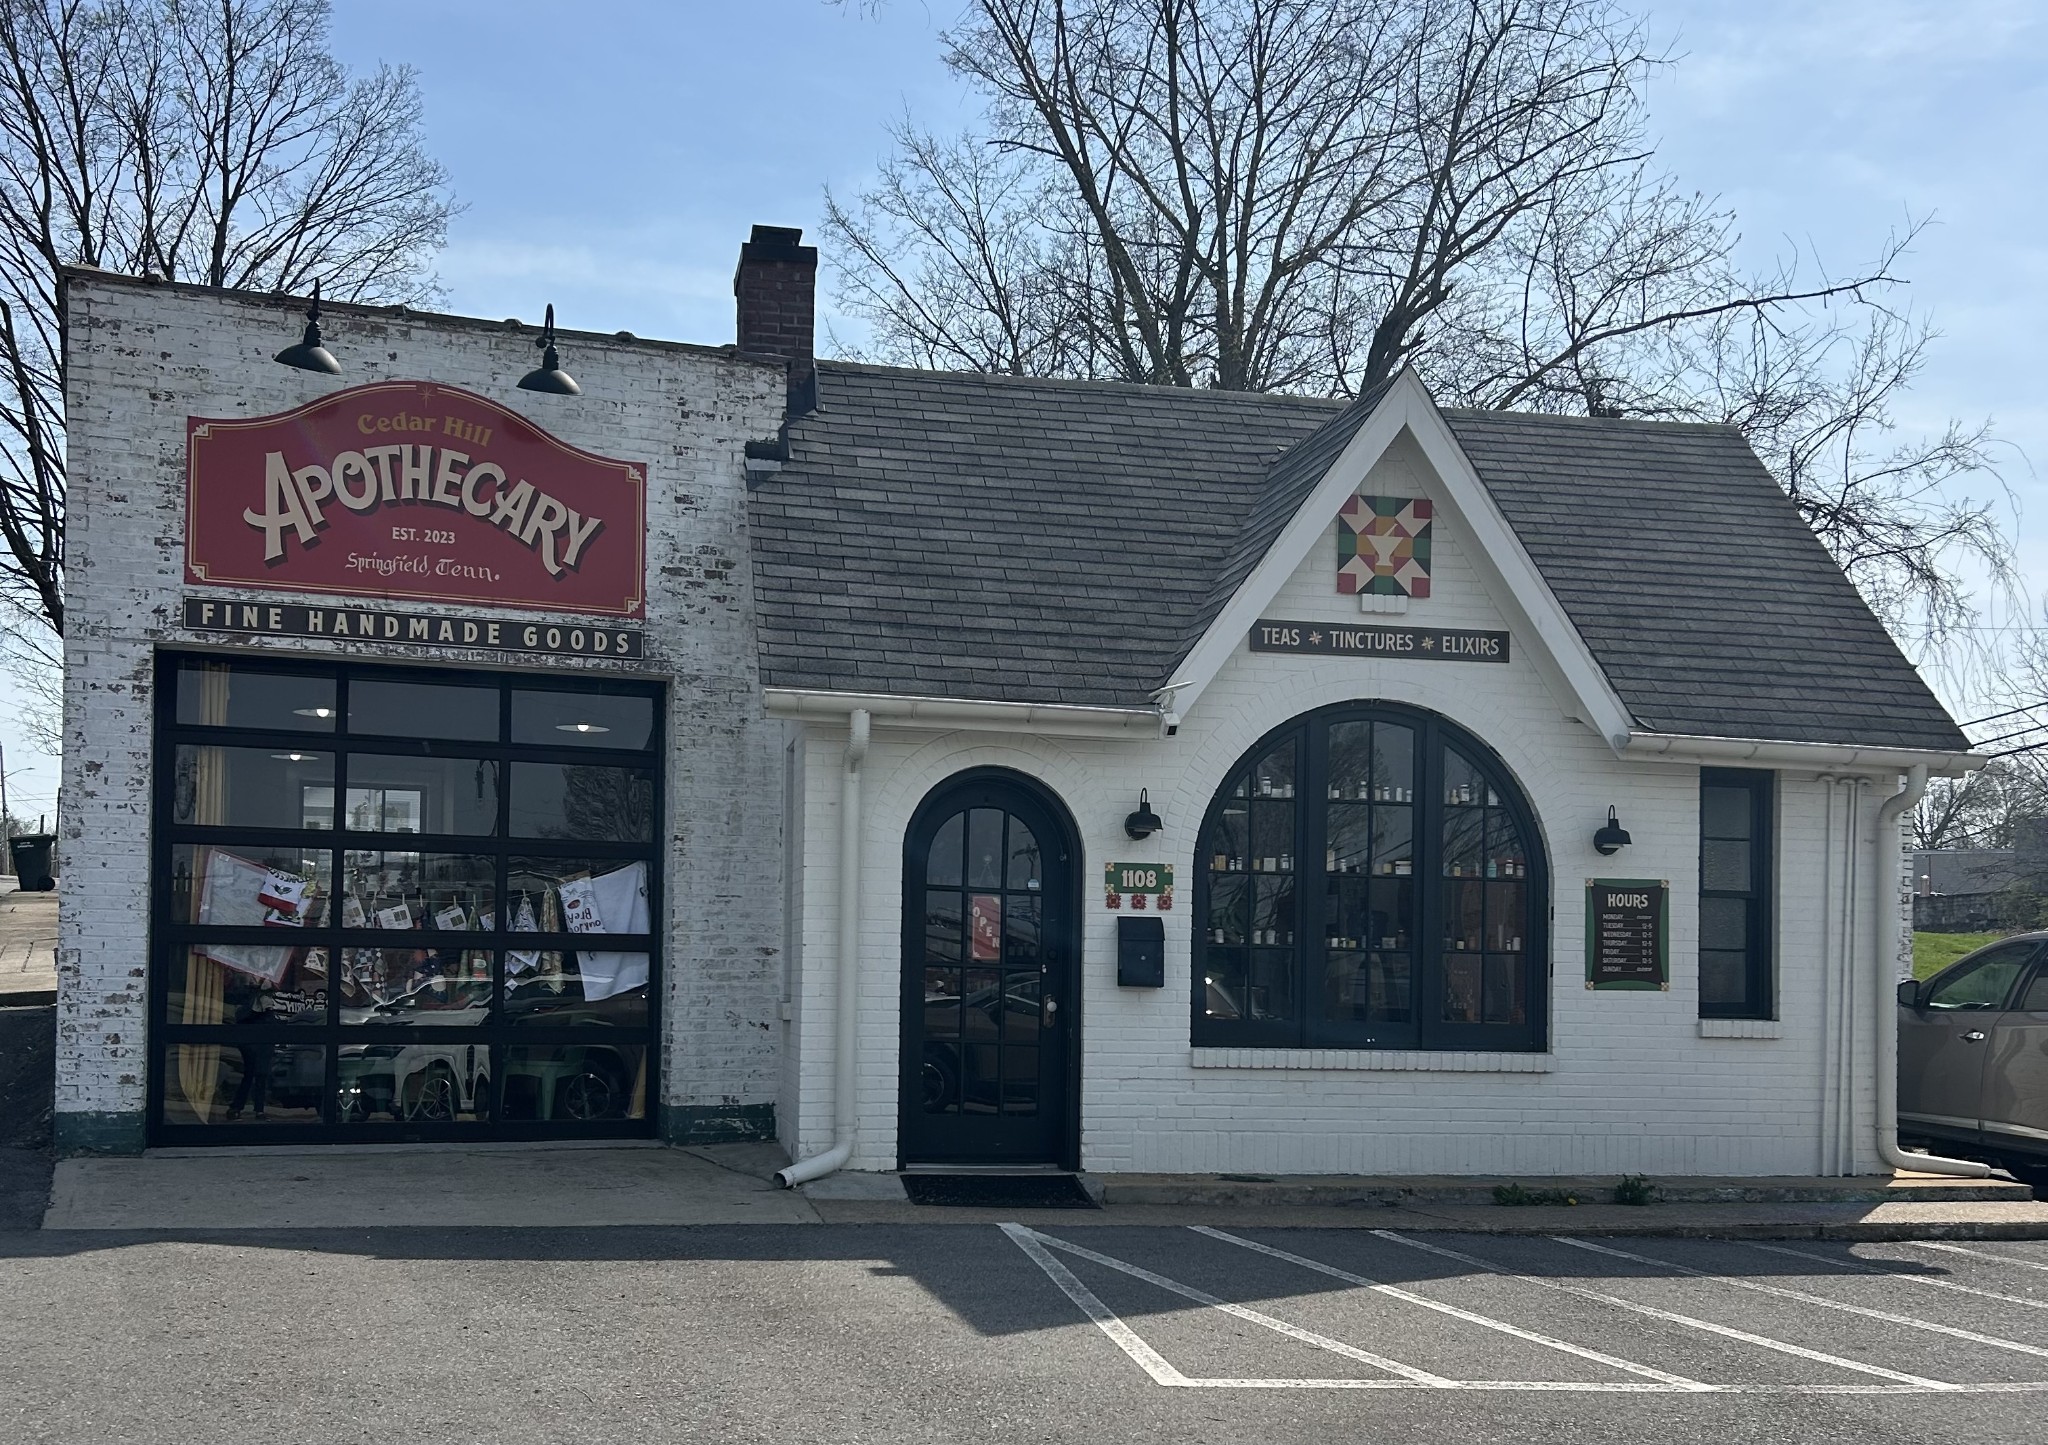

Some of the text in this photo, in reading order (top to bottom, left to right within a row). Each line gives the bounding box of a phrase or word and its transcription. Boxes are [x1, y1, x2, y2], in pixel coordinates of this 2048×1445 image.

[357, 411, 494, 447] Cedar Hill
[243, 444, 604, 578] APOTHECARY
[392, 526, 456, 545] EST. 2023
[435, 558, 501, 582] Tenn.
[202, 603, 630, 654] FINE HANDMADE GOODS
[1262, 627, 1500, 656] TEAS TINCTURES ELIXIRS
[1122, 870, 1157, 888] 1108
[1607, 893, 1649, 909] HOURS
[972, 906, 1000, 948] OPEN
